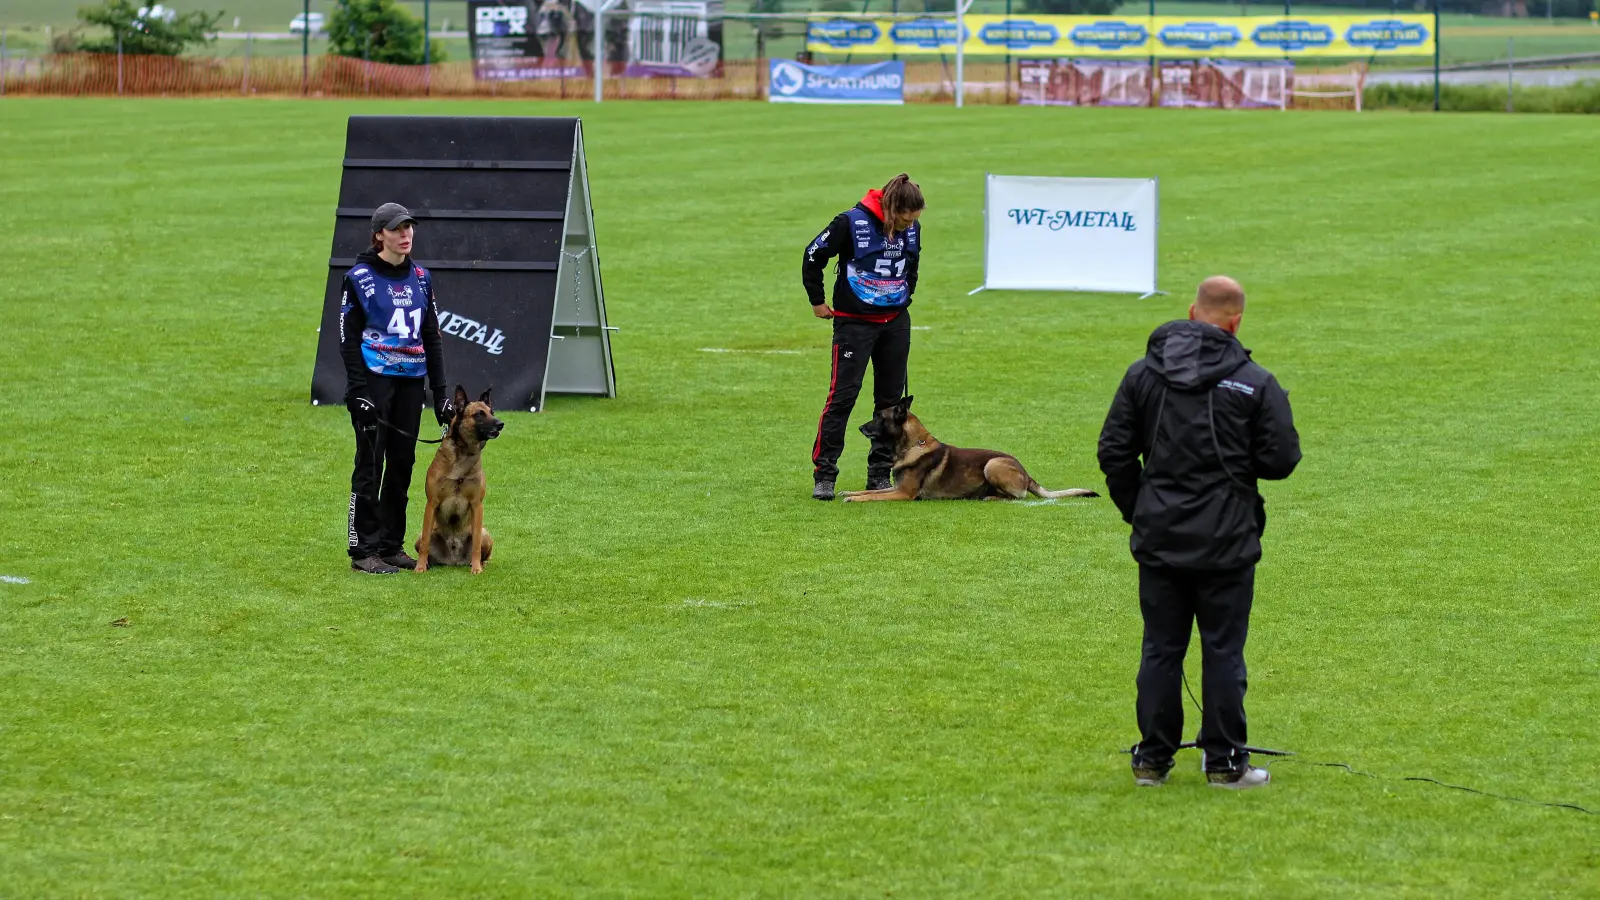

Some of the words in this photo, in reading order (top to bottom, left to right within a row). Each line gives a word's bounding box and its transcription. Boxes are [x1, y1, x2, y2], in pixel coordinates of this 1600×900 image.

[475, 6, 528, 20] DOG
[936, 28, 957, 39] PLU
[986, 29, 1025, 39] WINNER
[1076, 30, 1115, 40] WINNER
[1165, 31, 1206, 41] WINNER
[1208, 31, 1232, 41] PLUS
[1258, 30, 1299, 41] WINNER
[1301, 30, 1326, 41] PLUS
[1352, 30, 1391, 40] WINNER
[1393, 30, 1420, 40] PLUS
[806, 73, 901, 90] SPORTHUND
[874, 258, 906, 278] 51
[386, 307, 422, 339] 41
